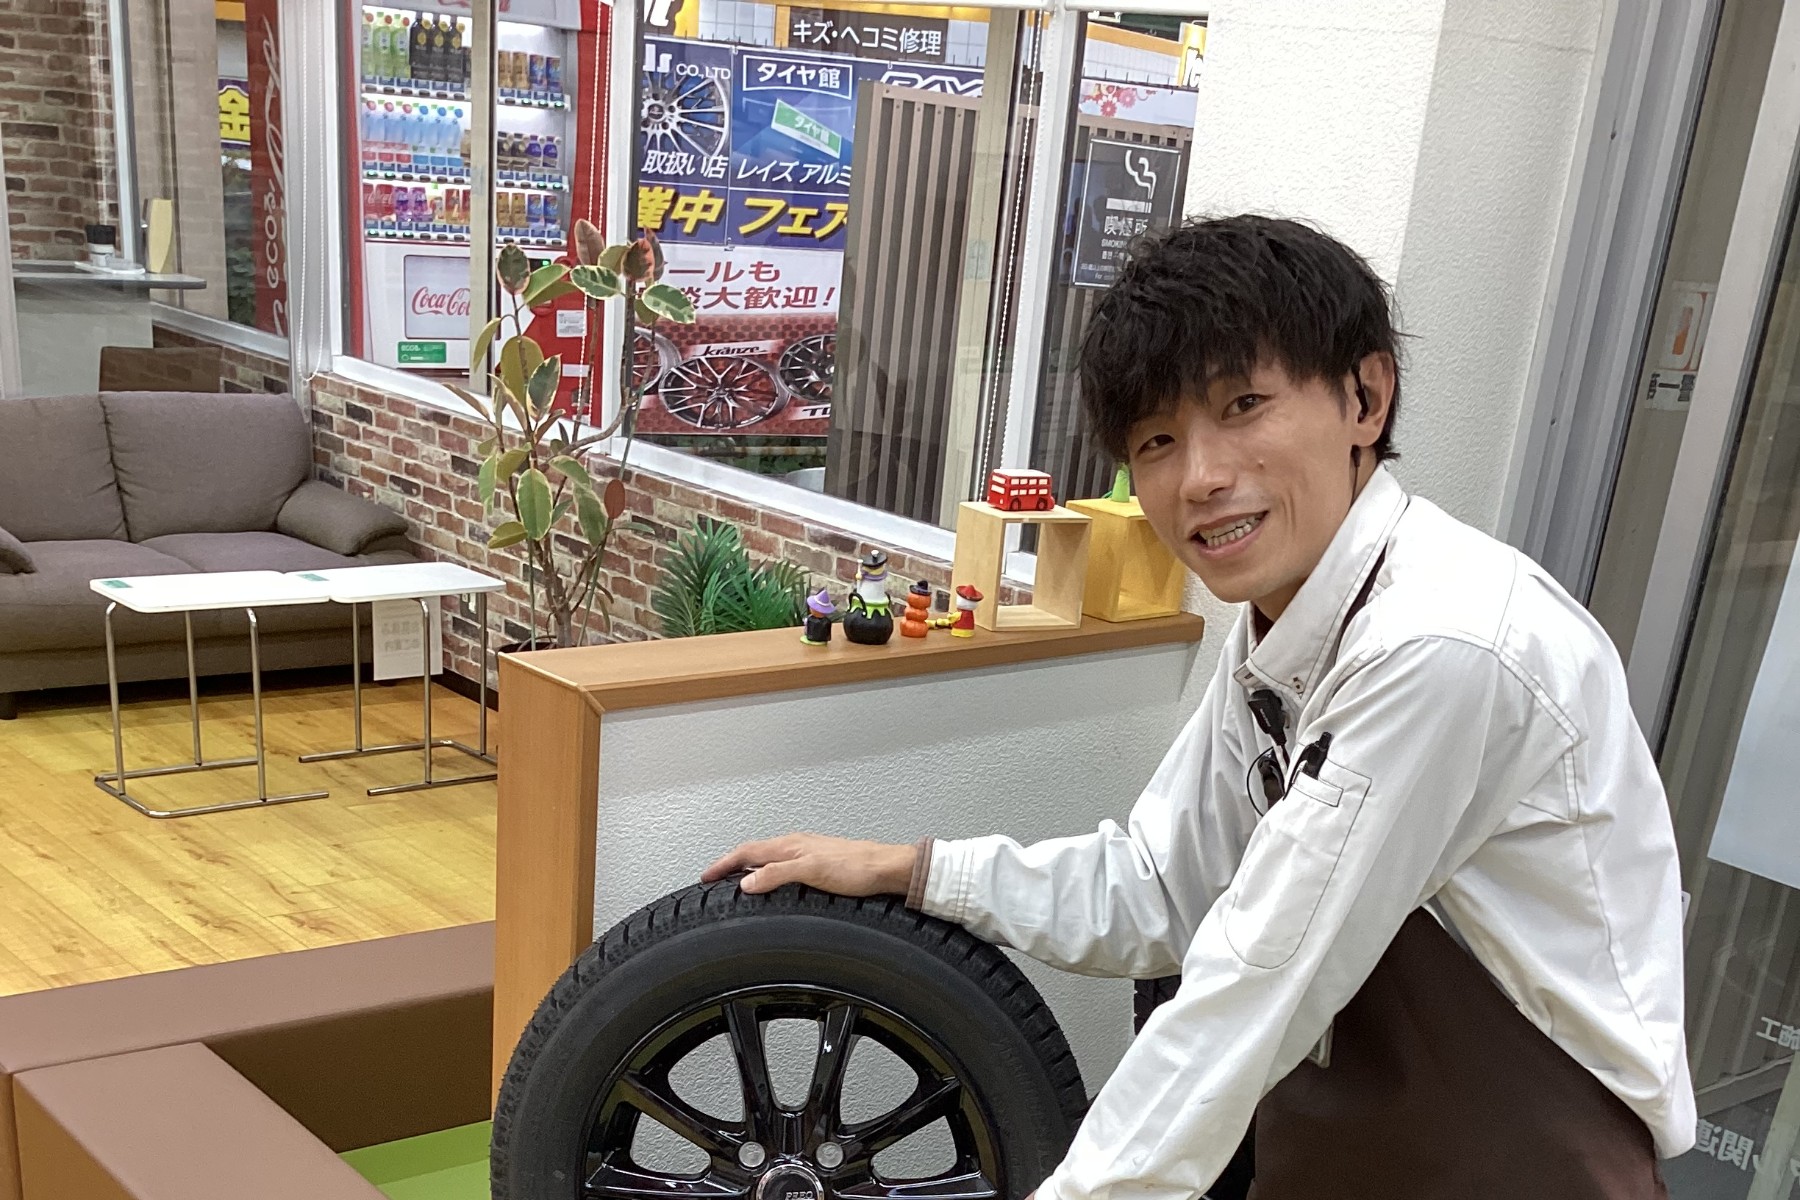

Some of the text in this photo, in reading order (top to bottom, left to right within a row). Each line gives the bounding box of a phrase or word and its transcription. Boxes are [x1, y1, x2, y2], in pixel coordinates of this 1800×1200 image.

[793, 19, 942, 56] キズ・ヘコミ修理
[757, 62, 841, 89] タイヤ館
[641, 150, 729, 179] 取扱い店
[736, 158, 799, 182] レイズ
[412, 286, 470, 316] Coca-Col
